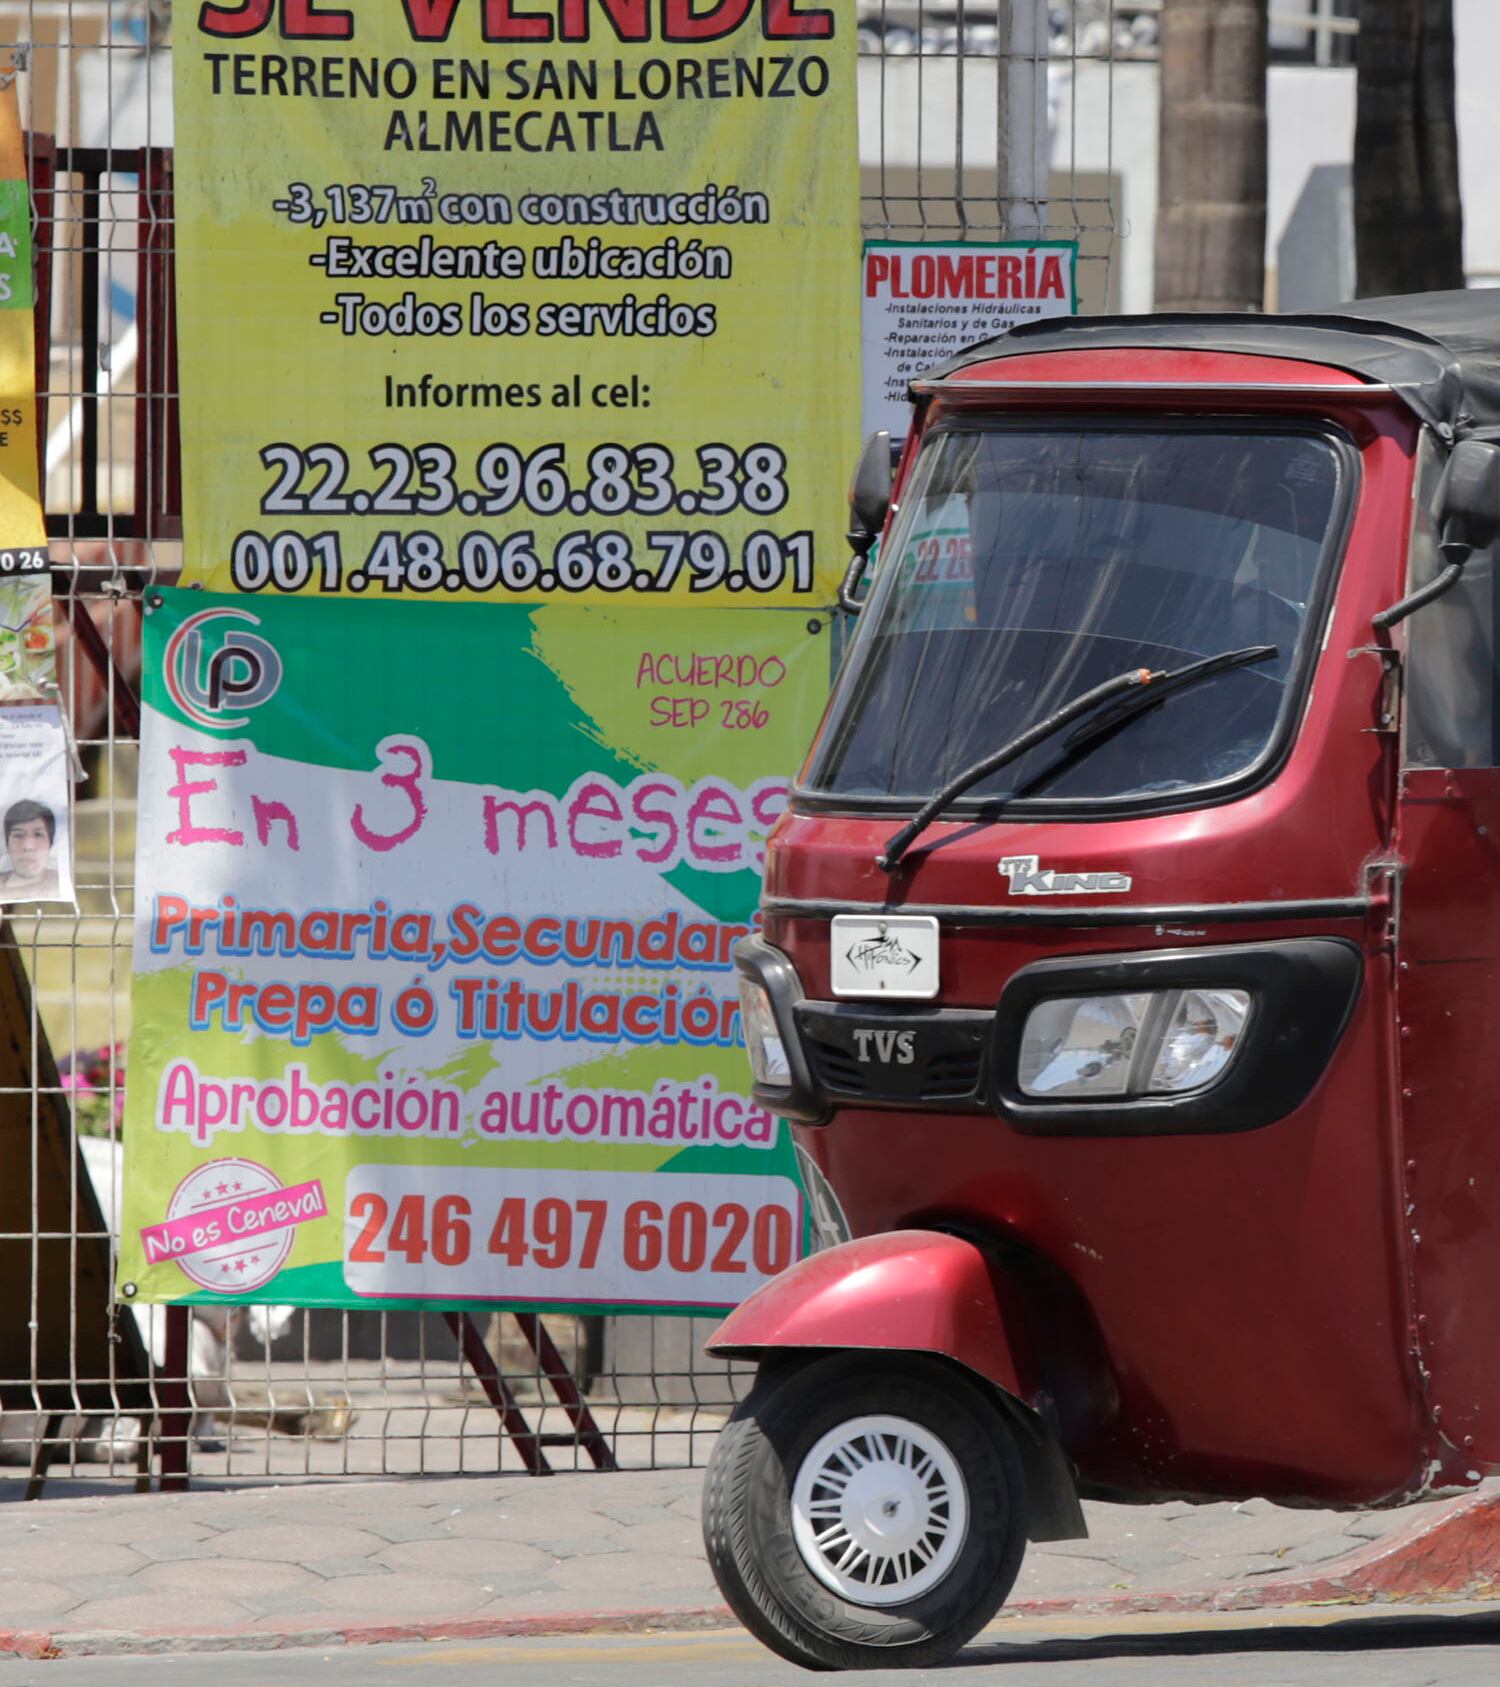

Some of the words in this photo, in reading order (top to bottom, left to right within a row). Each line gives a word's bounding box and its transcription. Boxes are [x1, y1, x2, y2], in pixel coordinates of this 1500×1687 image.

[204, 53, 417, 96] TERRENO
[432, 58, 490, 99] EN
[506, 60, 609, 100] SAN
[615, 55, 830, 99] LORENZO
[383, 110, 665, 152] ALMECATLA
[438, 194, 511, 225] con
[518, 183, 770, 225] construcción
[309, 235, 525, 279] -Excelente
[533, 237, 732, 279] ubicación
[866, 247, 1066, 299] PLOMERÍA
[320, 292, 462, 336] -Todos
[470, 293, 530, 336] los
[537, 295, 717, 337] servicios
[884, 302, 968, 315] -Instalaciones
[971, 302, 1042, 315] Hidráulicas
[897, 317, 957, 329] Sanitarios
[961, 319, 969, 331] y
[973, 318, 988, 329] de
[991, 318, 1015, 329] Gas
[884, 331, 956, 345] -Reparación
[960, 334, 975, 343] en
[884, 346, 954, 358] -Instalación
[896, 361, 911, 372] de
[385, 373, 542, 408] Informes
[551, 374, 581, 408] al
[591, 374, 651, 408] cel:
[259, 442, 789, 516] 22.23.96.83.38
[20, 551, 44, 569] 26
[230, 530, 814, 594] 001.48.06.68.79.01
[637, 652, 787, 689] ACUERDO
[650, 695, 710, 728] SEP
[719, 700, 770, 730] 286
[166, 744, 300, 852] En
[350, 744, 428, 853] 3
[195, 972, 379, 1042] Prepa
[397, 977, 437, 1031] ó
[853, 1028, 917, 1065] TVS
[161, 1063, 459, 1139] Aprobación
[481, 1080, 773, 1143] automática
[146, 1228, 187, 1260] No
[191, 1220, 222, 1248] es
[227, 1184, 323, 1234] Ceneval
[350, 1193, 471, 1265] 246
[489, 1198, 608, 1269] 497
[624, 1201, 791, 1276] 6020
